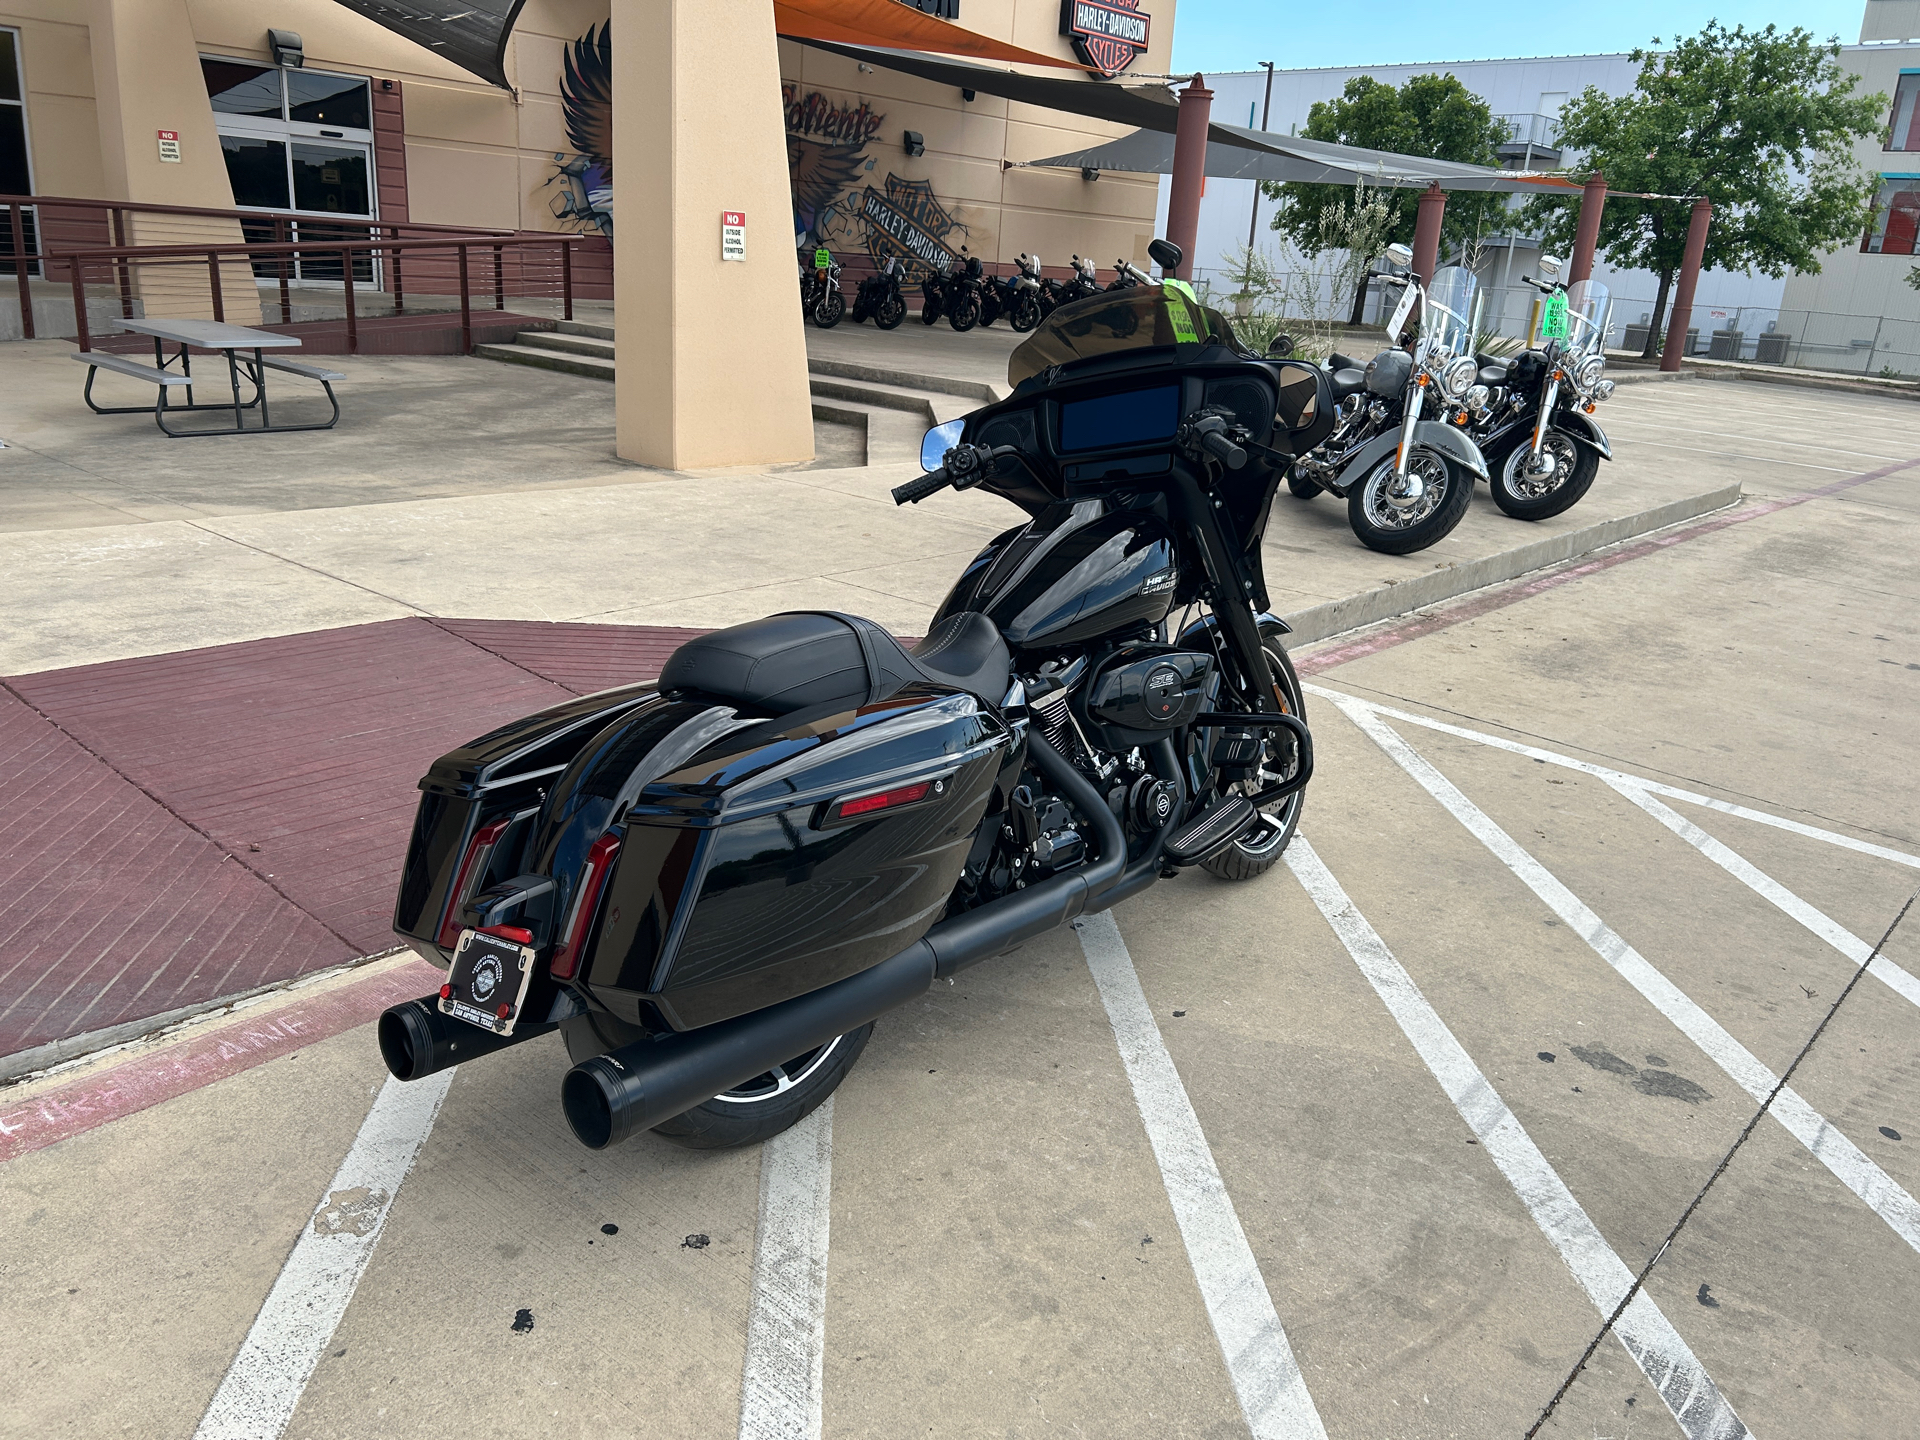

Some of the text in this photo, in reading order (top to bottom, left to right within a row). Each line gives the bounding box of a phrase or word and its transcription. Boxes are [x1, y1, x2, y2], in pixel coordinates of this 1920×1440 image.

[1077, 4, 1146, 42] HARLEY-DAVIDSON
[1092, 38, 1128, 69] CYCLES
[727, 214, 740, 225] NO
[893, 186, 942, 235] MOTOR
[725, 228, 741, 236] OUTSIDE
[865, 196, 952, 271] HARLEY-DAVIDSON
[1549, 317, 1563, 327] NOW
[455, 1008, 463, 1016] SAN
[480, 1018, 493, 1028] TEXAS
